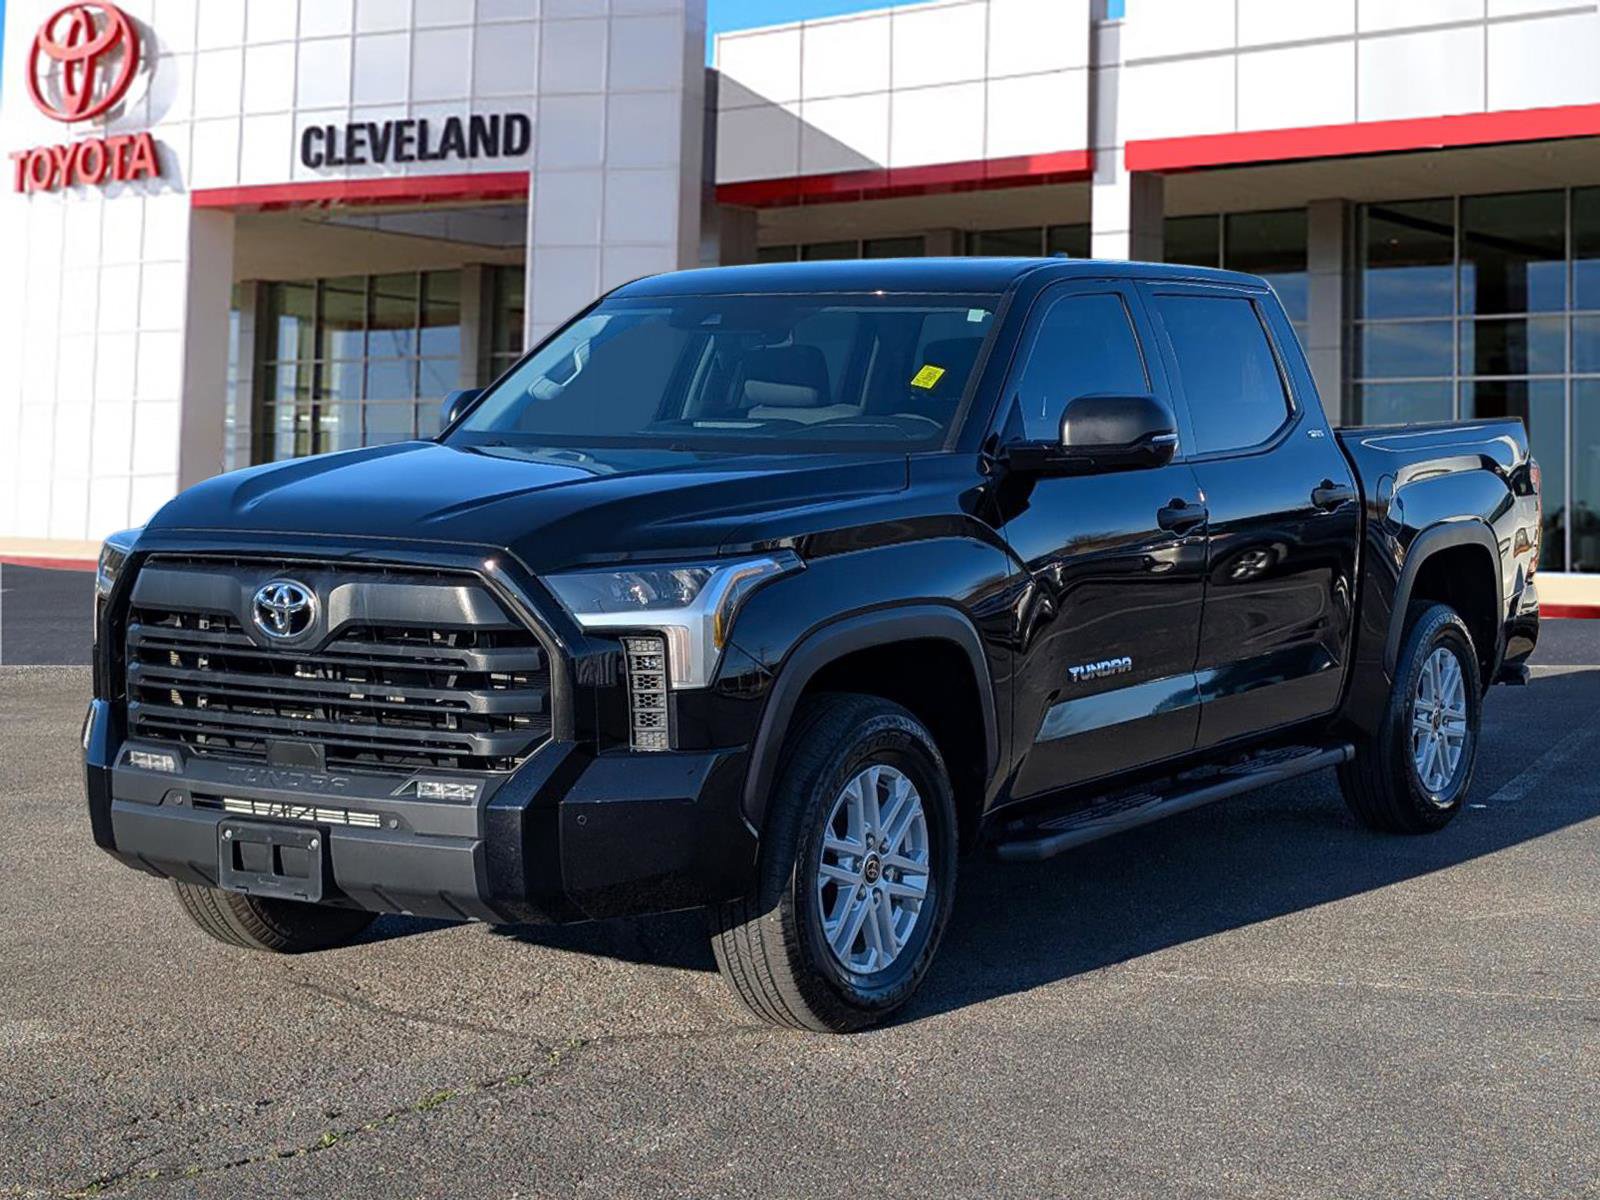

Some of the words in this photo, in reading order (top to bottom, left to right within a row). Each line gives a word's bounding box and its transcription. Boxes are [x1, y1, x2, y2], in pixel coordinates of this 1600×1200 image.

[9, 132, 161, 194] TOYOTA
[301, 113, 531, 169] CLEVELAND
[1068, 656, 1132, 682] TUNDRA
